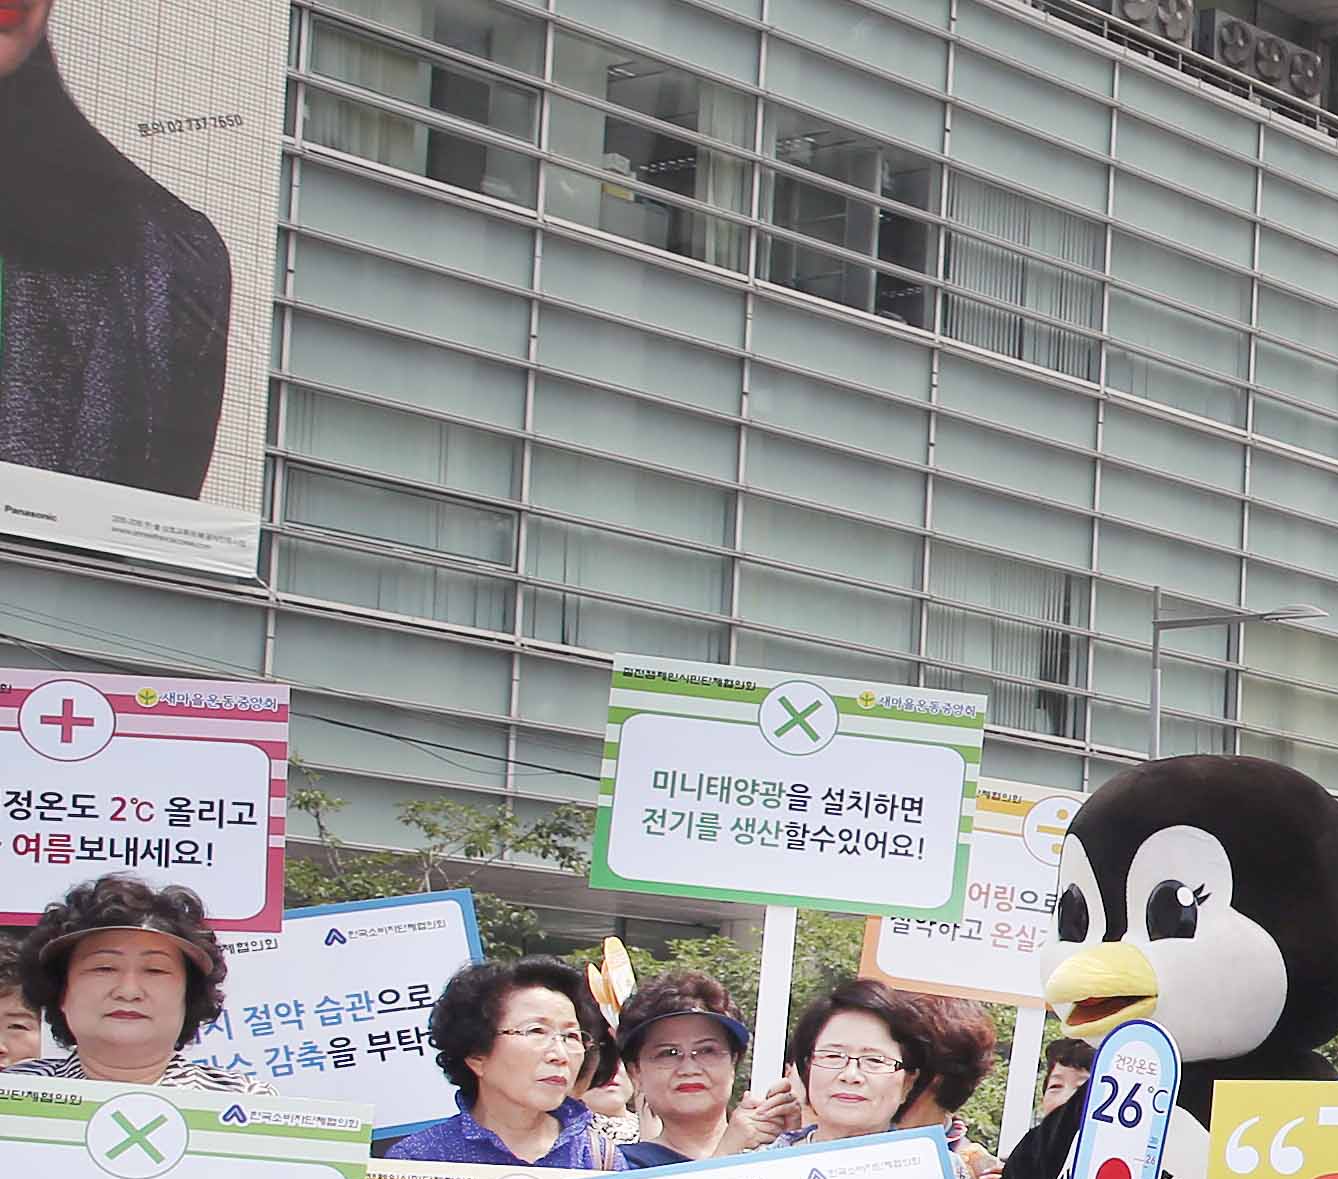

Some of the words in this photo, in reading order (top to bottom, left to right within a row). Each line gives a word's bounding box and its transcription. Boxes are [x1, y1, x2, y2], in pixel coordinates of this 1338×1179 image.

[4, 504, 57, 521] Panasonic
[3, 790, 99, 822] 정온도
[164, 798, 258, 829] 올리고
[652, 770, 812, 812] 미니태양광을
[821, 787, 924, 824] 설치하면
[12, 832, 214, 868] 여름보내세요!
[641, 808, 722, 842] 전기를
[730, 817, 925, 860] 생산할수있어요!
[243, 1000, 305, 1037] 절약
[314, 984, 435, 1027] 습관으로
[264, 1036, 357, 1078] 감축을
[367, 1026, 436, 1062] 부탁
[1115, 1054, 1157, 1076] 건강온도
